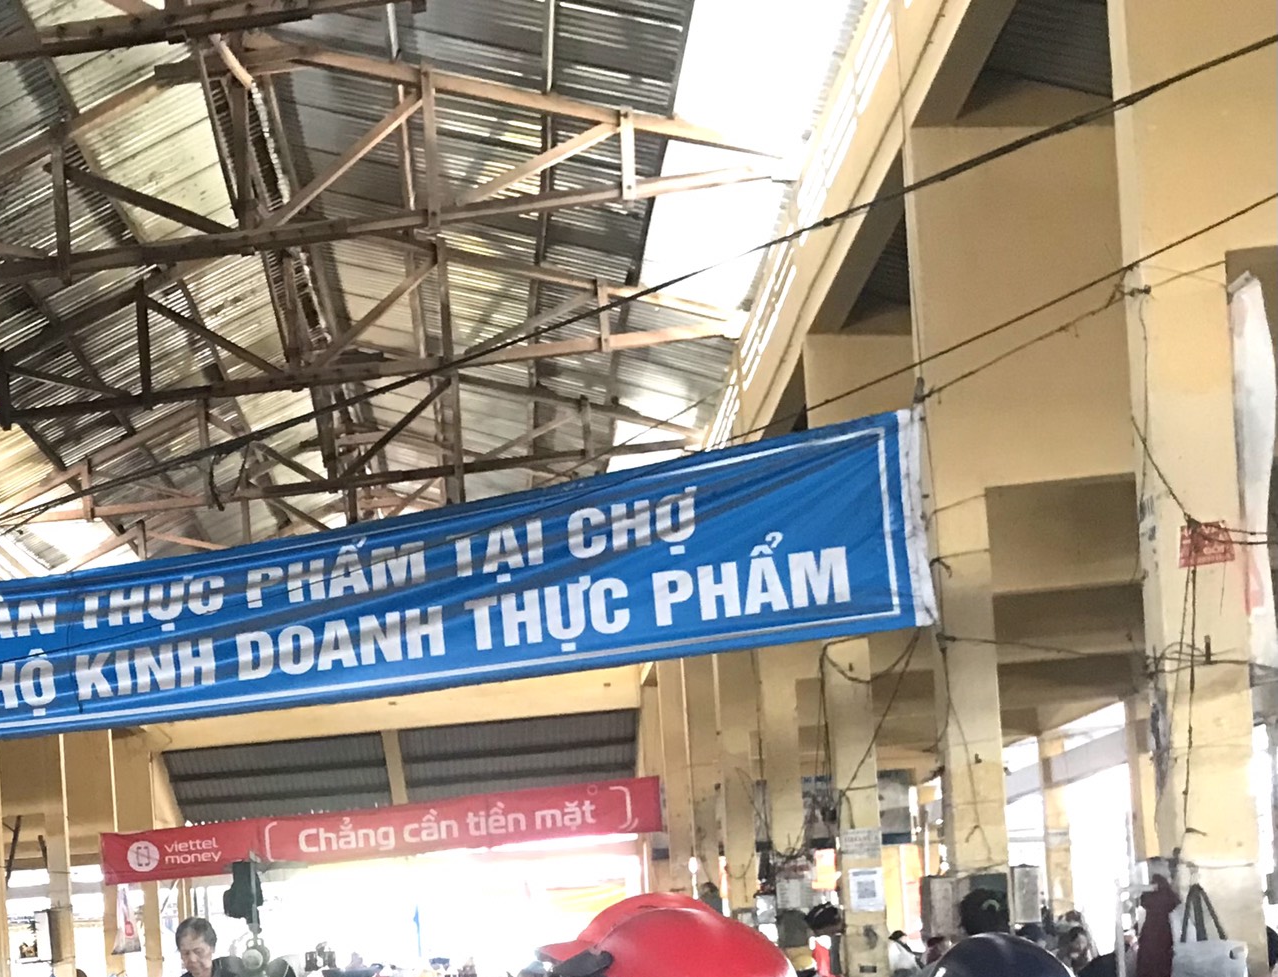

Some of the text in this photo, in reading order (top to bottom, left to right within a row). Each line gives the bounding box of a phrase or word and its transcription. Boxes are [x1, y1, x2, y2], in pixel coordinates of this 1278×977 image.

[81, 574, 225, 632] THỰC
[445, 518, 544, 583] TẠI
[567, 486, 697, 556] CHỢ
[75, 637, 216, 701] KINH
[235, 605, 446, 681] DOANH
[464, 575, 631, 652] THỰC
[651, 531, 852, 627] PHẨM
[164, 837, 219, 853] viettel
[298, 800, 597, 852] Chẳng cần tiền mặt
[165, 850, 222, 865] money
